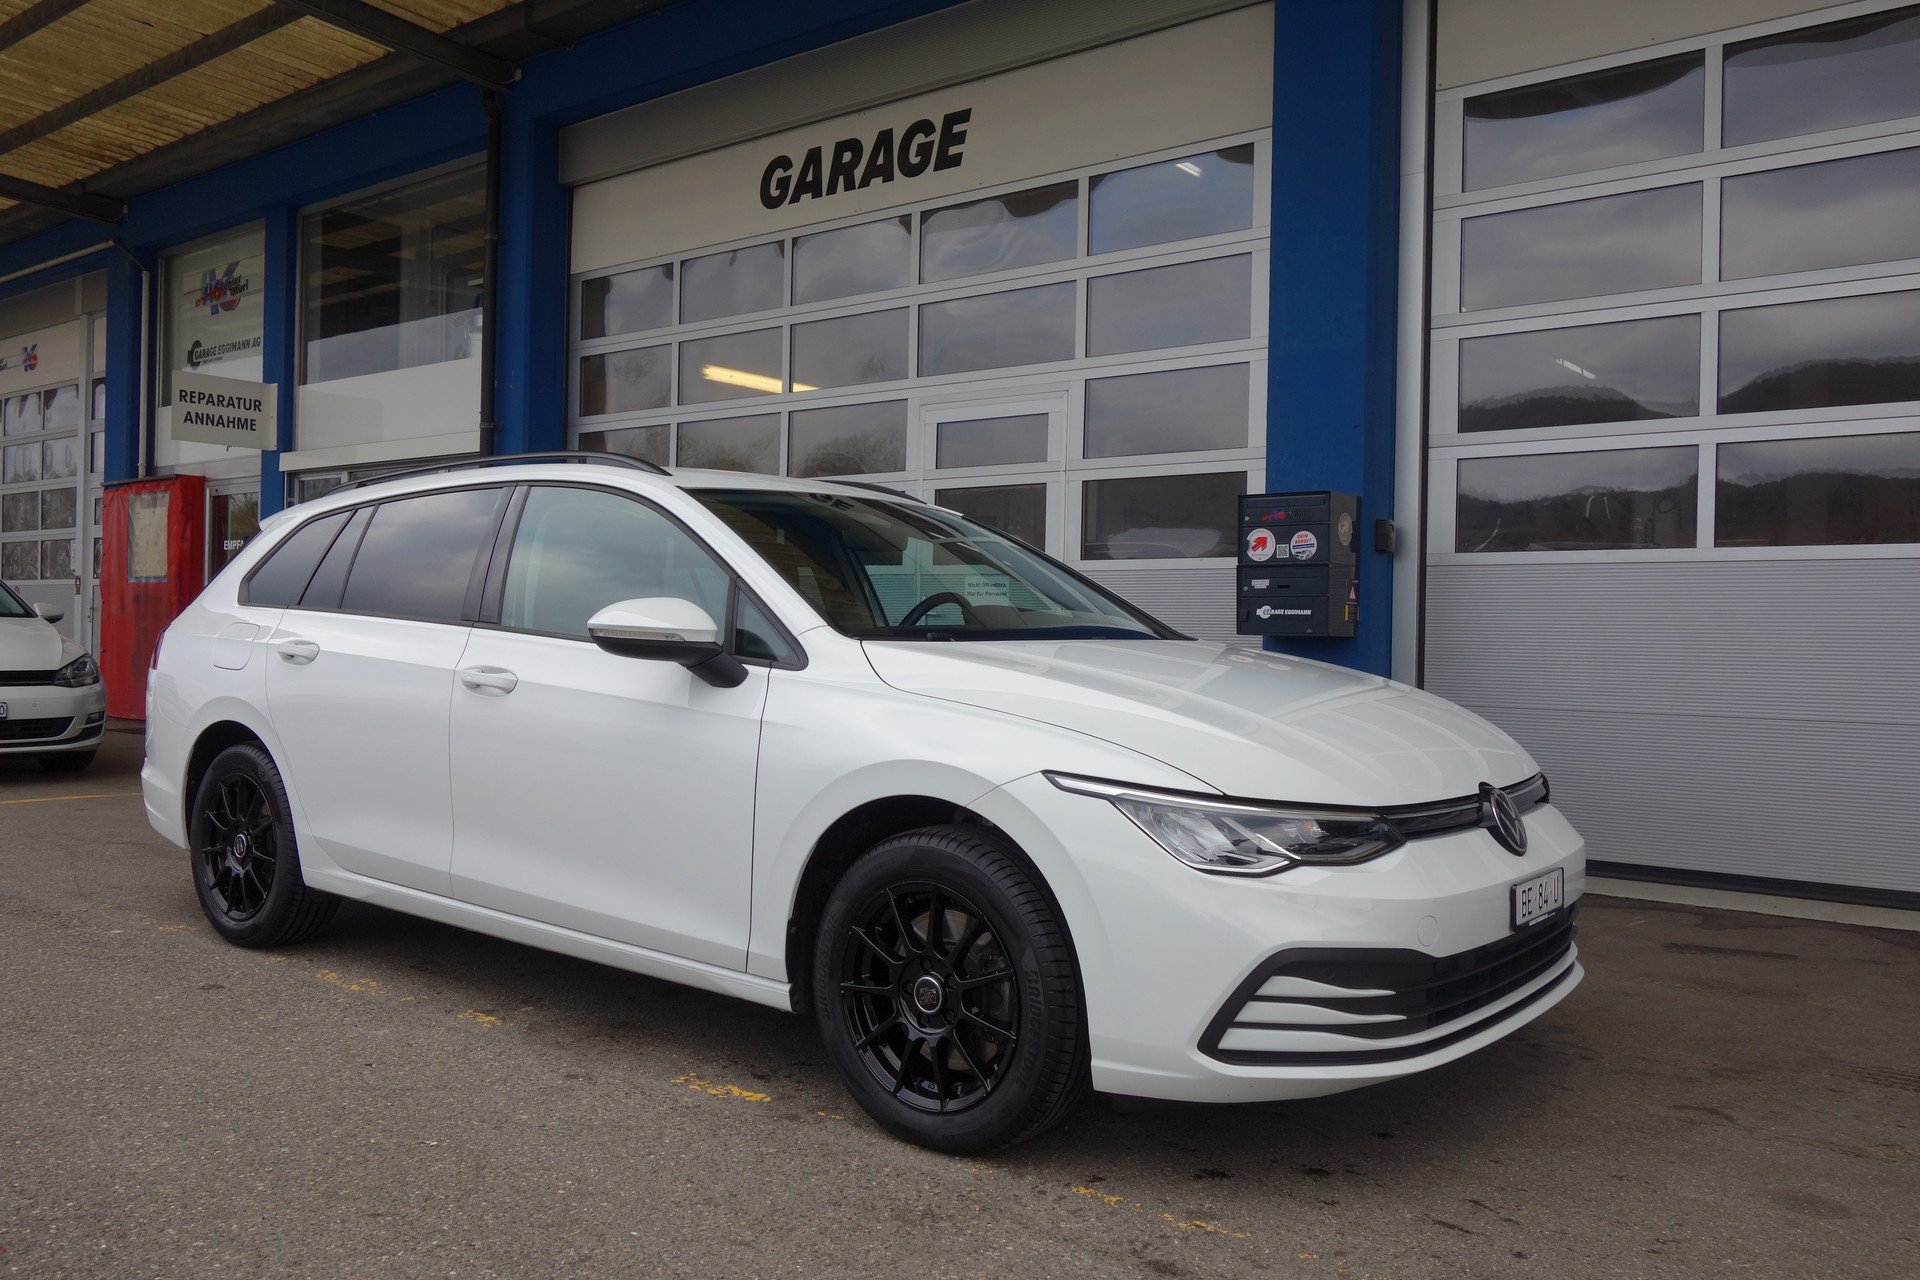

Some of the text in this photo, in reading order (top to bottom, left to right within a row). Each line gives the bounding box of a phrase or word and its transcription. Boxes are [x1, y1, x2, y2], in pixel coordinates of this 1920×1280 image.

[759, 107, 972, 211] GARAGE
[194, 346, 217, 361] GARAGE
[218, 338, 251, 355] EGGIMANN
[251, 337, 261, 348] AG
[179, 388, 262, 413] REPARATUR
[183, 410, 257, 432] ANNAHME
[1015, 970, 1042, 1090] BRIDGESTONE
